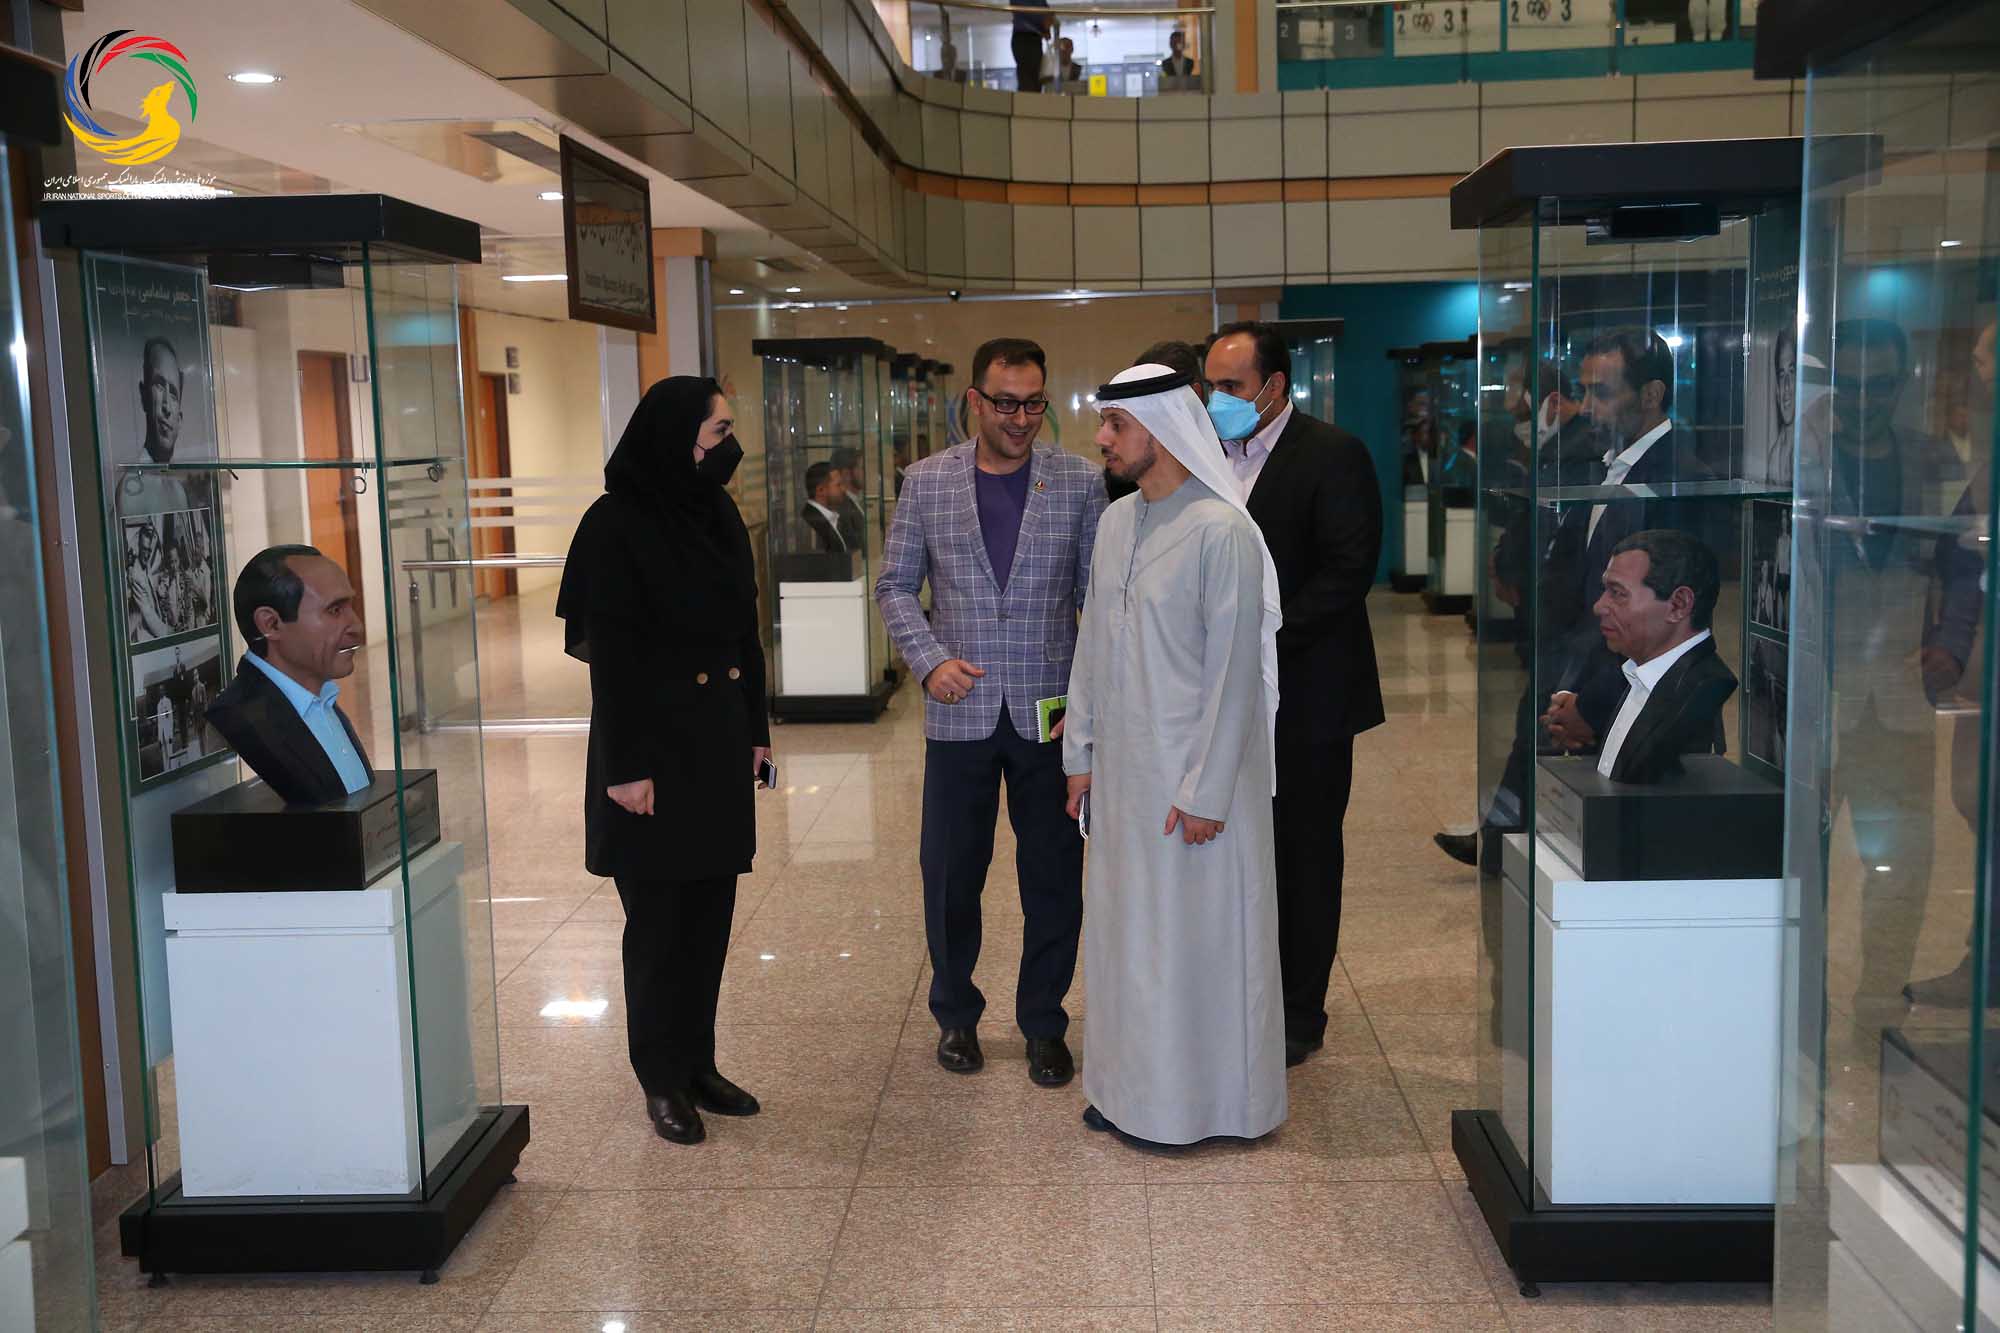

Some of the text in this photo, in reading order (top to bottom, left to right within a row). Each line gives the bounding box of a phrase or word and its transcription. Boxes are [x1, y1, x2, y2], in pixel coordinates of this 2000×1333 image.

[1397, 9, 1454, 34] 2 3
[1511, 0, 1572, 22] 2 3
[1280, 22, 1355, 40] 2 3
